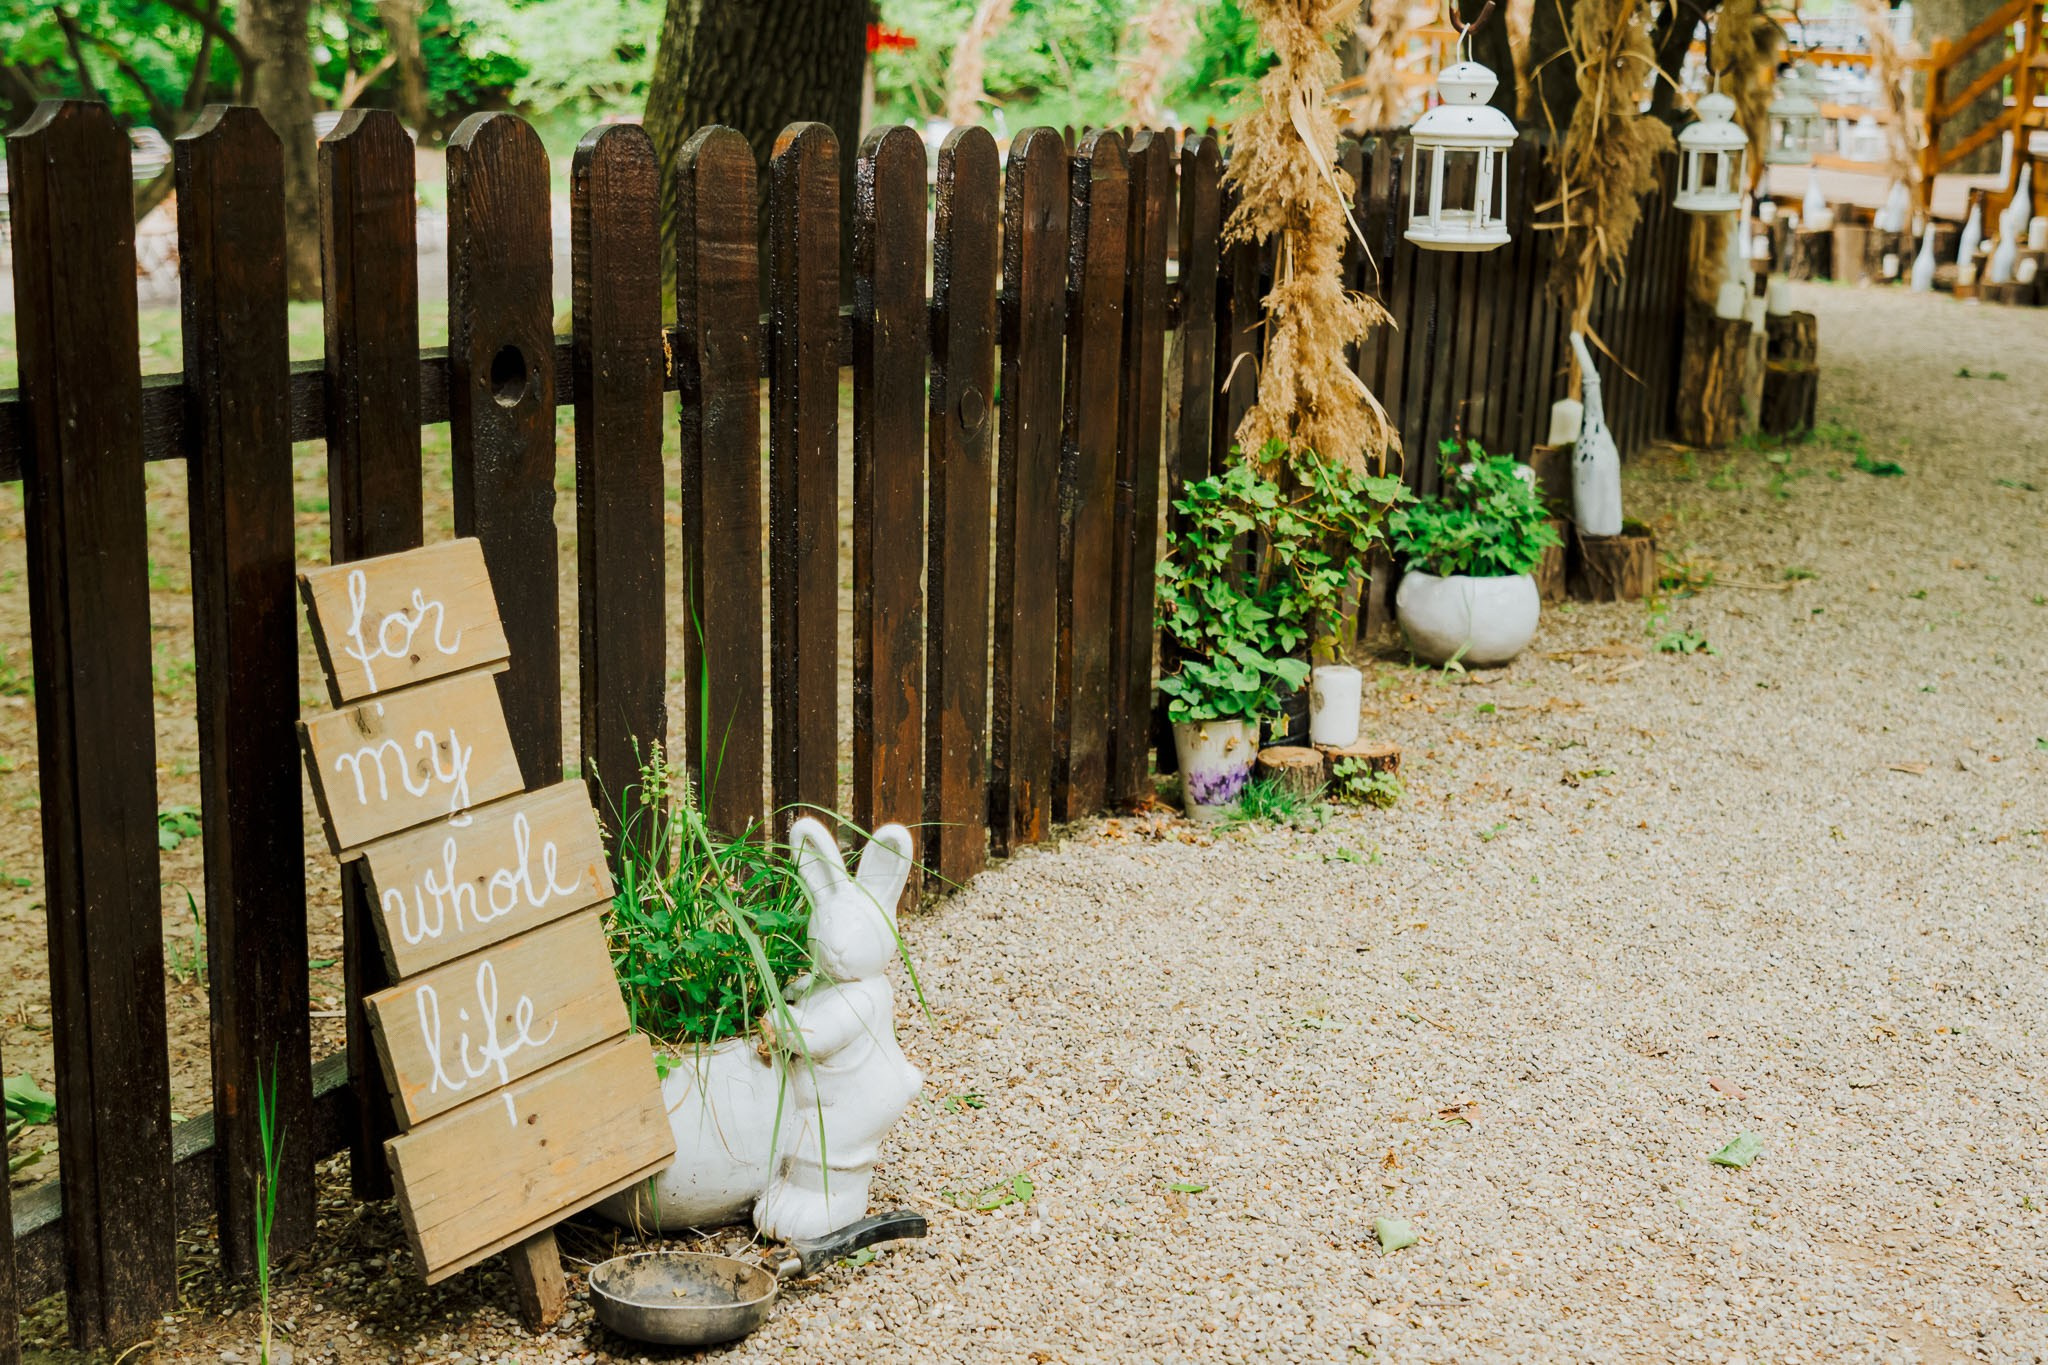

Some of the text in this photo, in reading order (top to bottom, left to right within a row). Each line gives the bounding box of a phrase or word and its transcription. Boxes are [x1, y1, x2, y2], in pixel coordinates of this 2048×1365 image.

[345, 569, 462, 717] for
[335, 728, 473, 827] my
[381, 811, 583, 944] whole
[416, 960, 558, 1127] life
